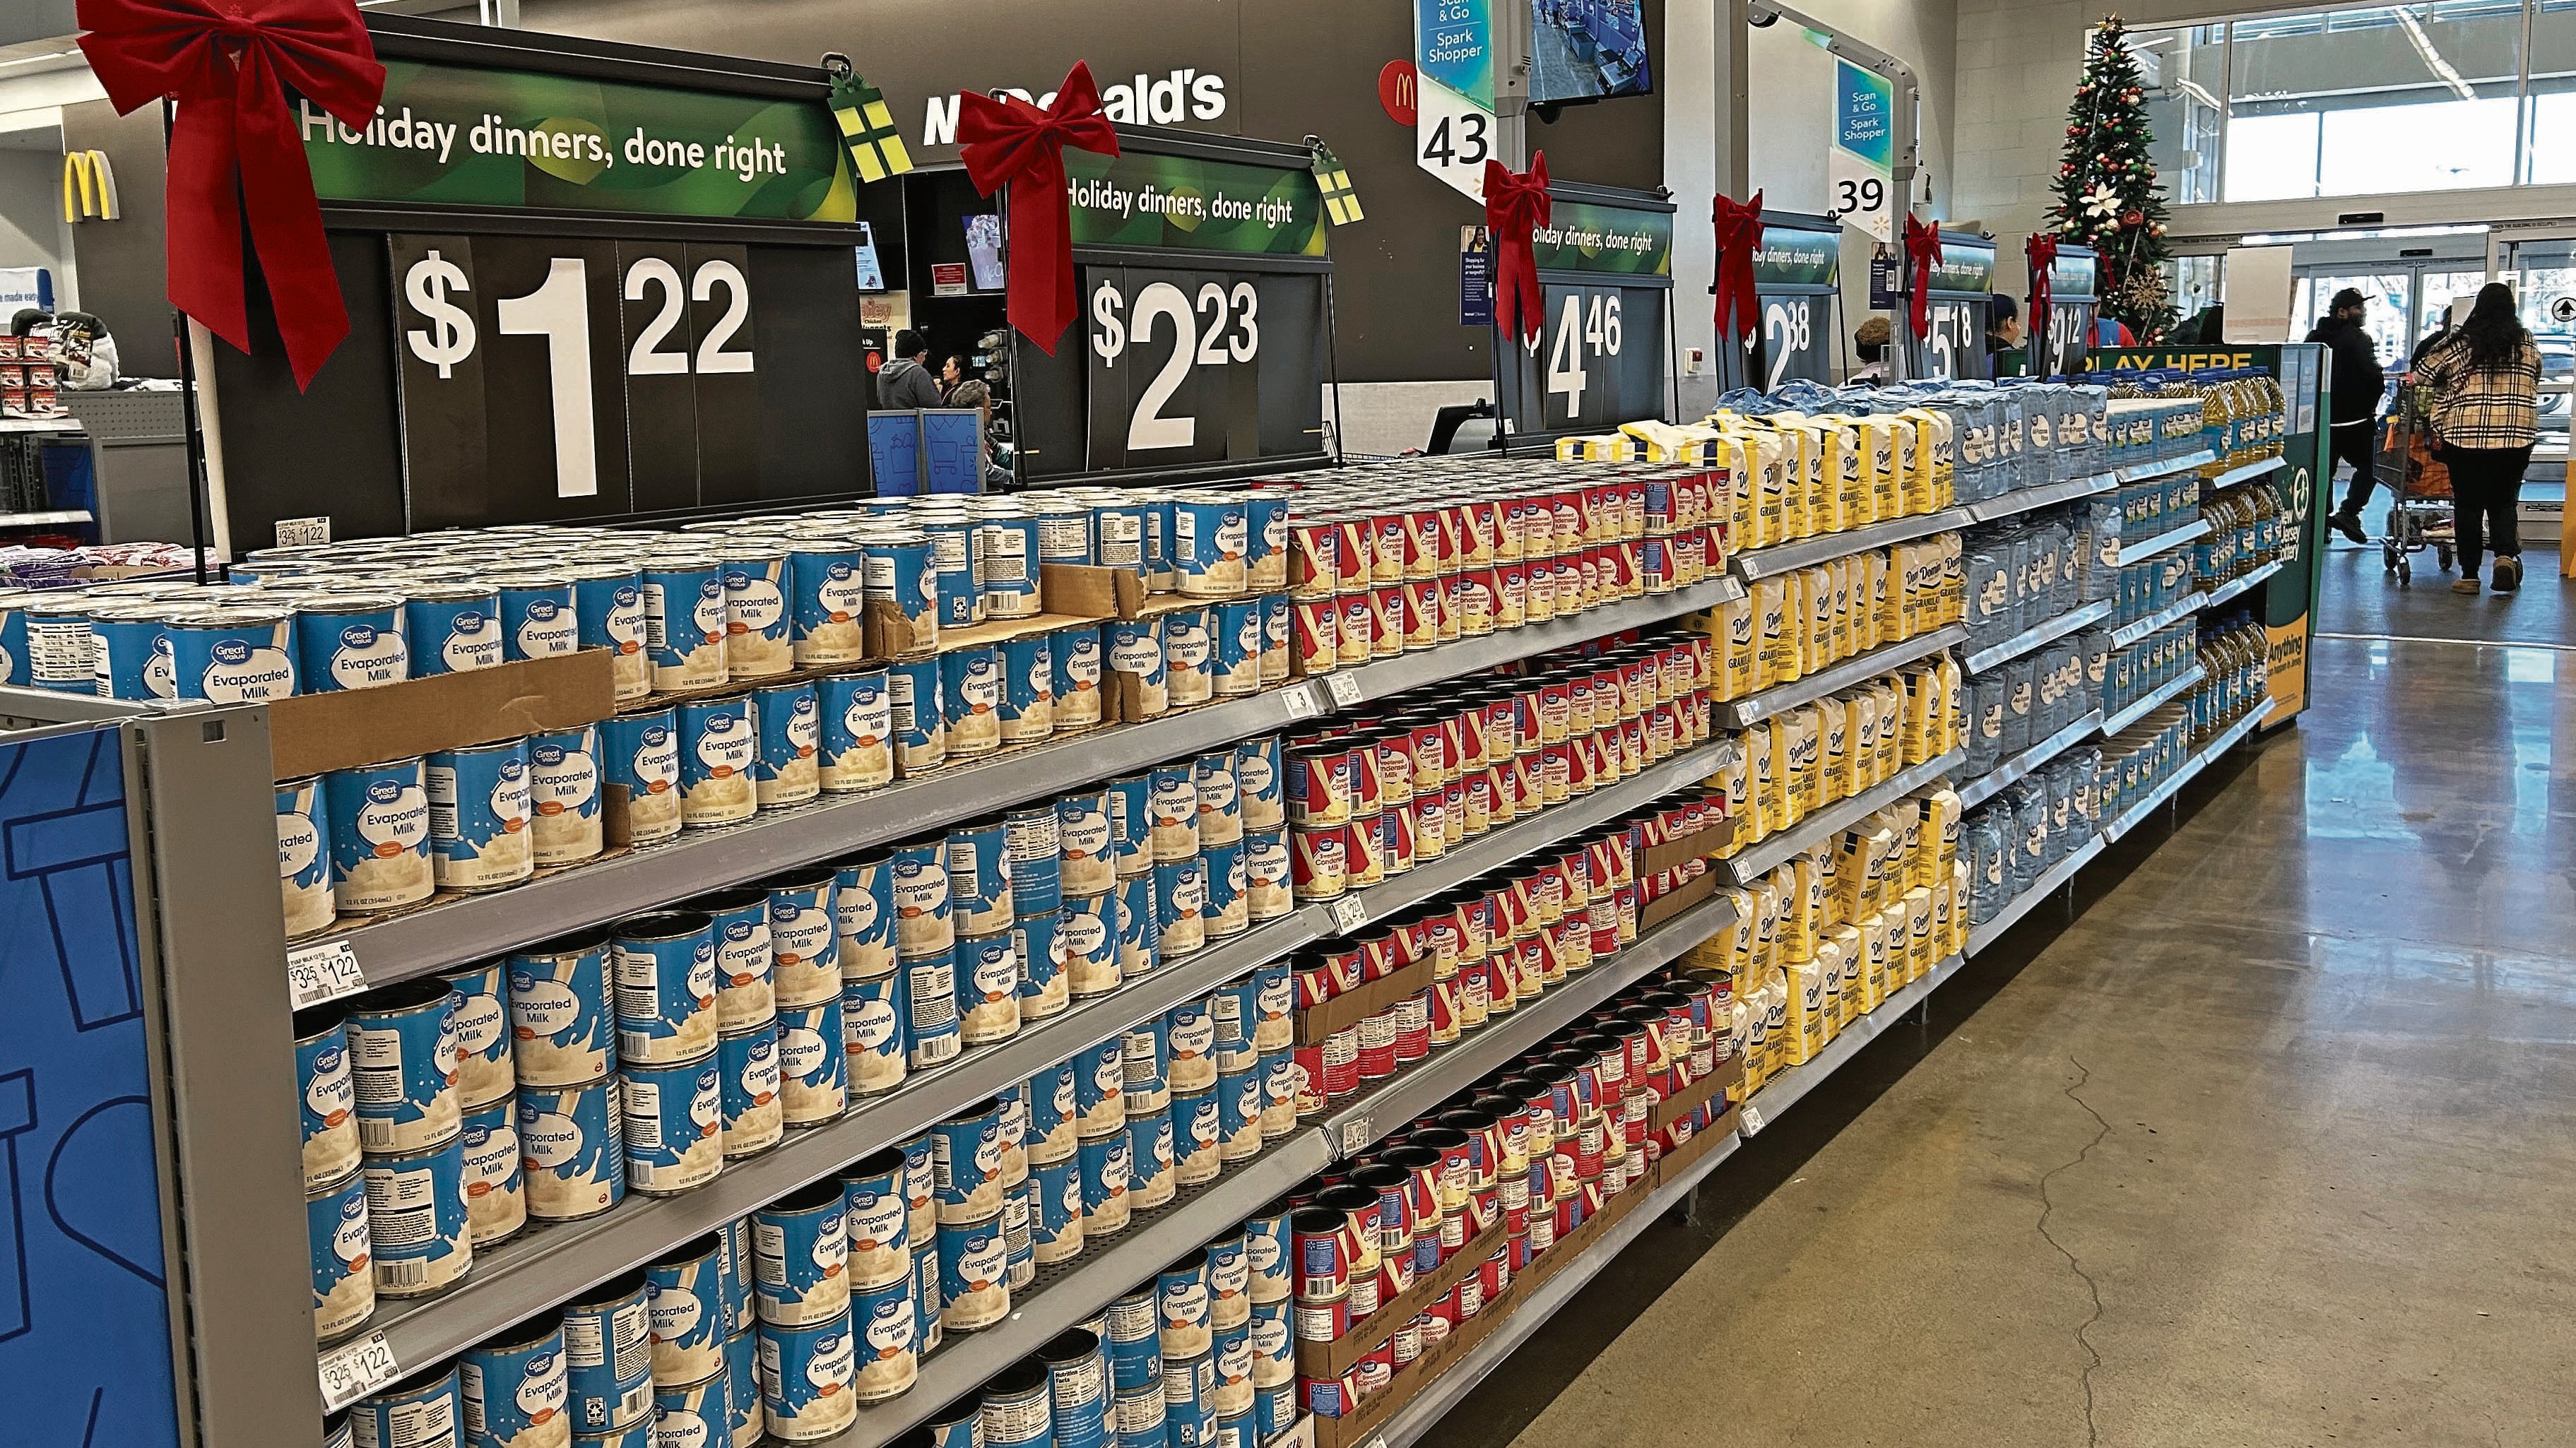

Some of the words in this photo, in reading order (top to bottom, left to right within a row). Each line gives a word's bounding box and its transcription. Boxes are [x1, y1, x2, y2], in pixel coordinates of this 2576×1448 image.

[1439, 10, 1447, 22] &
[1451, 6, 1470, 20] Go
[1437, 28, 1473, 49] Spark
[1429, 45, 1482, 64] Shopper
[1853, 92, 1876, 102] Scan
[1861, 102, 1877, 112] Go
[1850, 118, 1879, 130] Spark
[1424, 114, 1488, 167] 43
[1844, 129, 1886, 141] Shopper
[471, 114, 614, 169] dinners,
[625, 127, 704, 168] done
[714, 135, 787, 182] right
[1837, 179, 1884, 213] 39
[1138, 184, 1207, 220] dinners,
[1212, 193, 1252, 220] done
[1255, 197, 1293, 230] right
[1532, 223, 1563, 251] oliday
[1565, 225, 1603, 250] dinners,
[1605, 229, 1629, 249] done
[1630, 232, 1653, 256] right
[1767, 247, 1793, 266] dinners,
[1793, 248, 1809, 263] done
[1809, 249, 1826, 269] right
[1961, 261, 1973, 275] done
[1973, 263, 1985, 278] right
[2281, 543, 2300, 562] ottery
[726, 575, 745, 585] Great
[727, 596, 779, 609] vaporated
[531, 605, 554, 615] Great
[740, 607, 762, 619] Milk
[456, 617, 480, 627] Great
[345, 630, 372, 641] Great
[549, 641, 568, 652] Milk
[1167, 638, 1207, 651] Evaporated
[2268, 634, 2302, 663] Anything
[215, 646, 246, 657] Great
[1113, 650, 1159, 661] Evaporated
[341, 650, 406, 670] Evaporated
[475, 653, 494, 665] Milk
[1130, 659, 1145, 670] Milk
[213, 667, 289, 687] Evaporated
[368, 669, 391, 682] Milk
[242, 686, 269, 699] Milk
[855, 690, 874, 701] Great
[709, 717, 731, 727] Great
[536, 750, 560, 760] Great
[726, 749, 744, 761] Milk
[532, 769, 593, 786] Evaporated
[370, 787, 397, 798] Great
[555, 784, 578, 796] Milk
[1171, 804, 1186, 813] Milk
[393, 824, 415, 836] Milk
[1062, 824, 1107, 838] Evaporated
[1079, 836, 1096, 846] Milk
[1263, 865, 1277, 875] Milk
[896, 879, 945, 894] Evaporated
[914, 891, 933, 903] Milk
[728, 926, 749, 937] Great
[792, 937, 813, 949] Milk
[745, 956, 763, 967] Milk
[456, 1010, 499, 1029] porated
[526, 1012, 550, 1023] Milk
[459, 1028, 483, 1042] Milk
[856, 1027, 877, 1038] Milk
[781, 1042, 820, 1058] porated
[317, 1052, 338, 1067] Great
[781, 1056, 802, 1067] Milk
[522, 1130, 574, 1145] aporated
[531, 1144, 553, 1156] Milk
[482, 1162, 504, 1177] Milk
[851, 1206, 902, 1227] Evaporated
[870, 1222, 889, 1235] Milk
[1248, 1245, 1277, 1256] porated
[650, 1303, 695, 1318] porated
[1182, 1306, 1197, 1316] Milk
[653, 1317, 675, 1328] Milk
[892, 1328, 907, 1343] Milk
[546, 1385, 563, 1404] Milk
